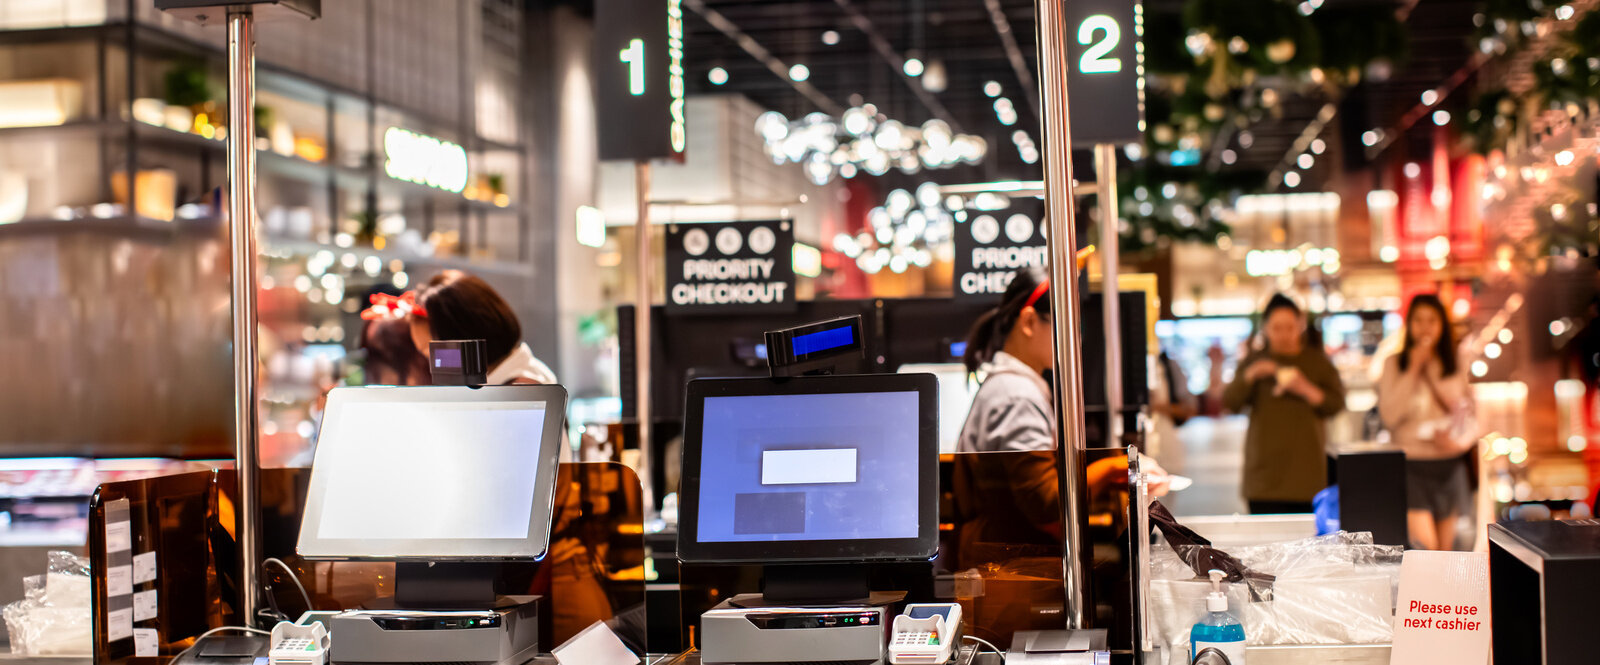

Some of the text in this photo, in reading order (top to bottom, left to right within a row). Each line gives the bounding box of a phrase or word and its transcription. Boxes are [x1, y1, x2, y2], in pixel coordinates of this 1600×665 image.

[1077, 14, 1122, 74] 2
[619, 38, 645, 97] 1
[683, 258, 775, 281] PRIORITY
[671, 281, 788, 305] CHECKOUT
[1409, 600, 1478, 616] Please use
[1403, 617, 1481, 631] next cashier
